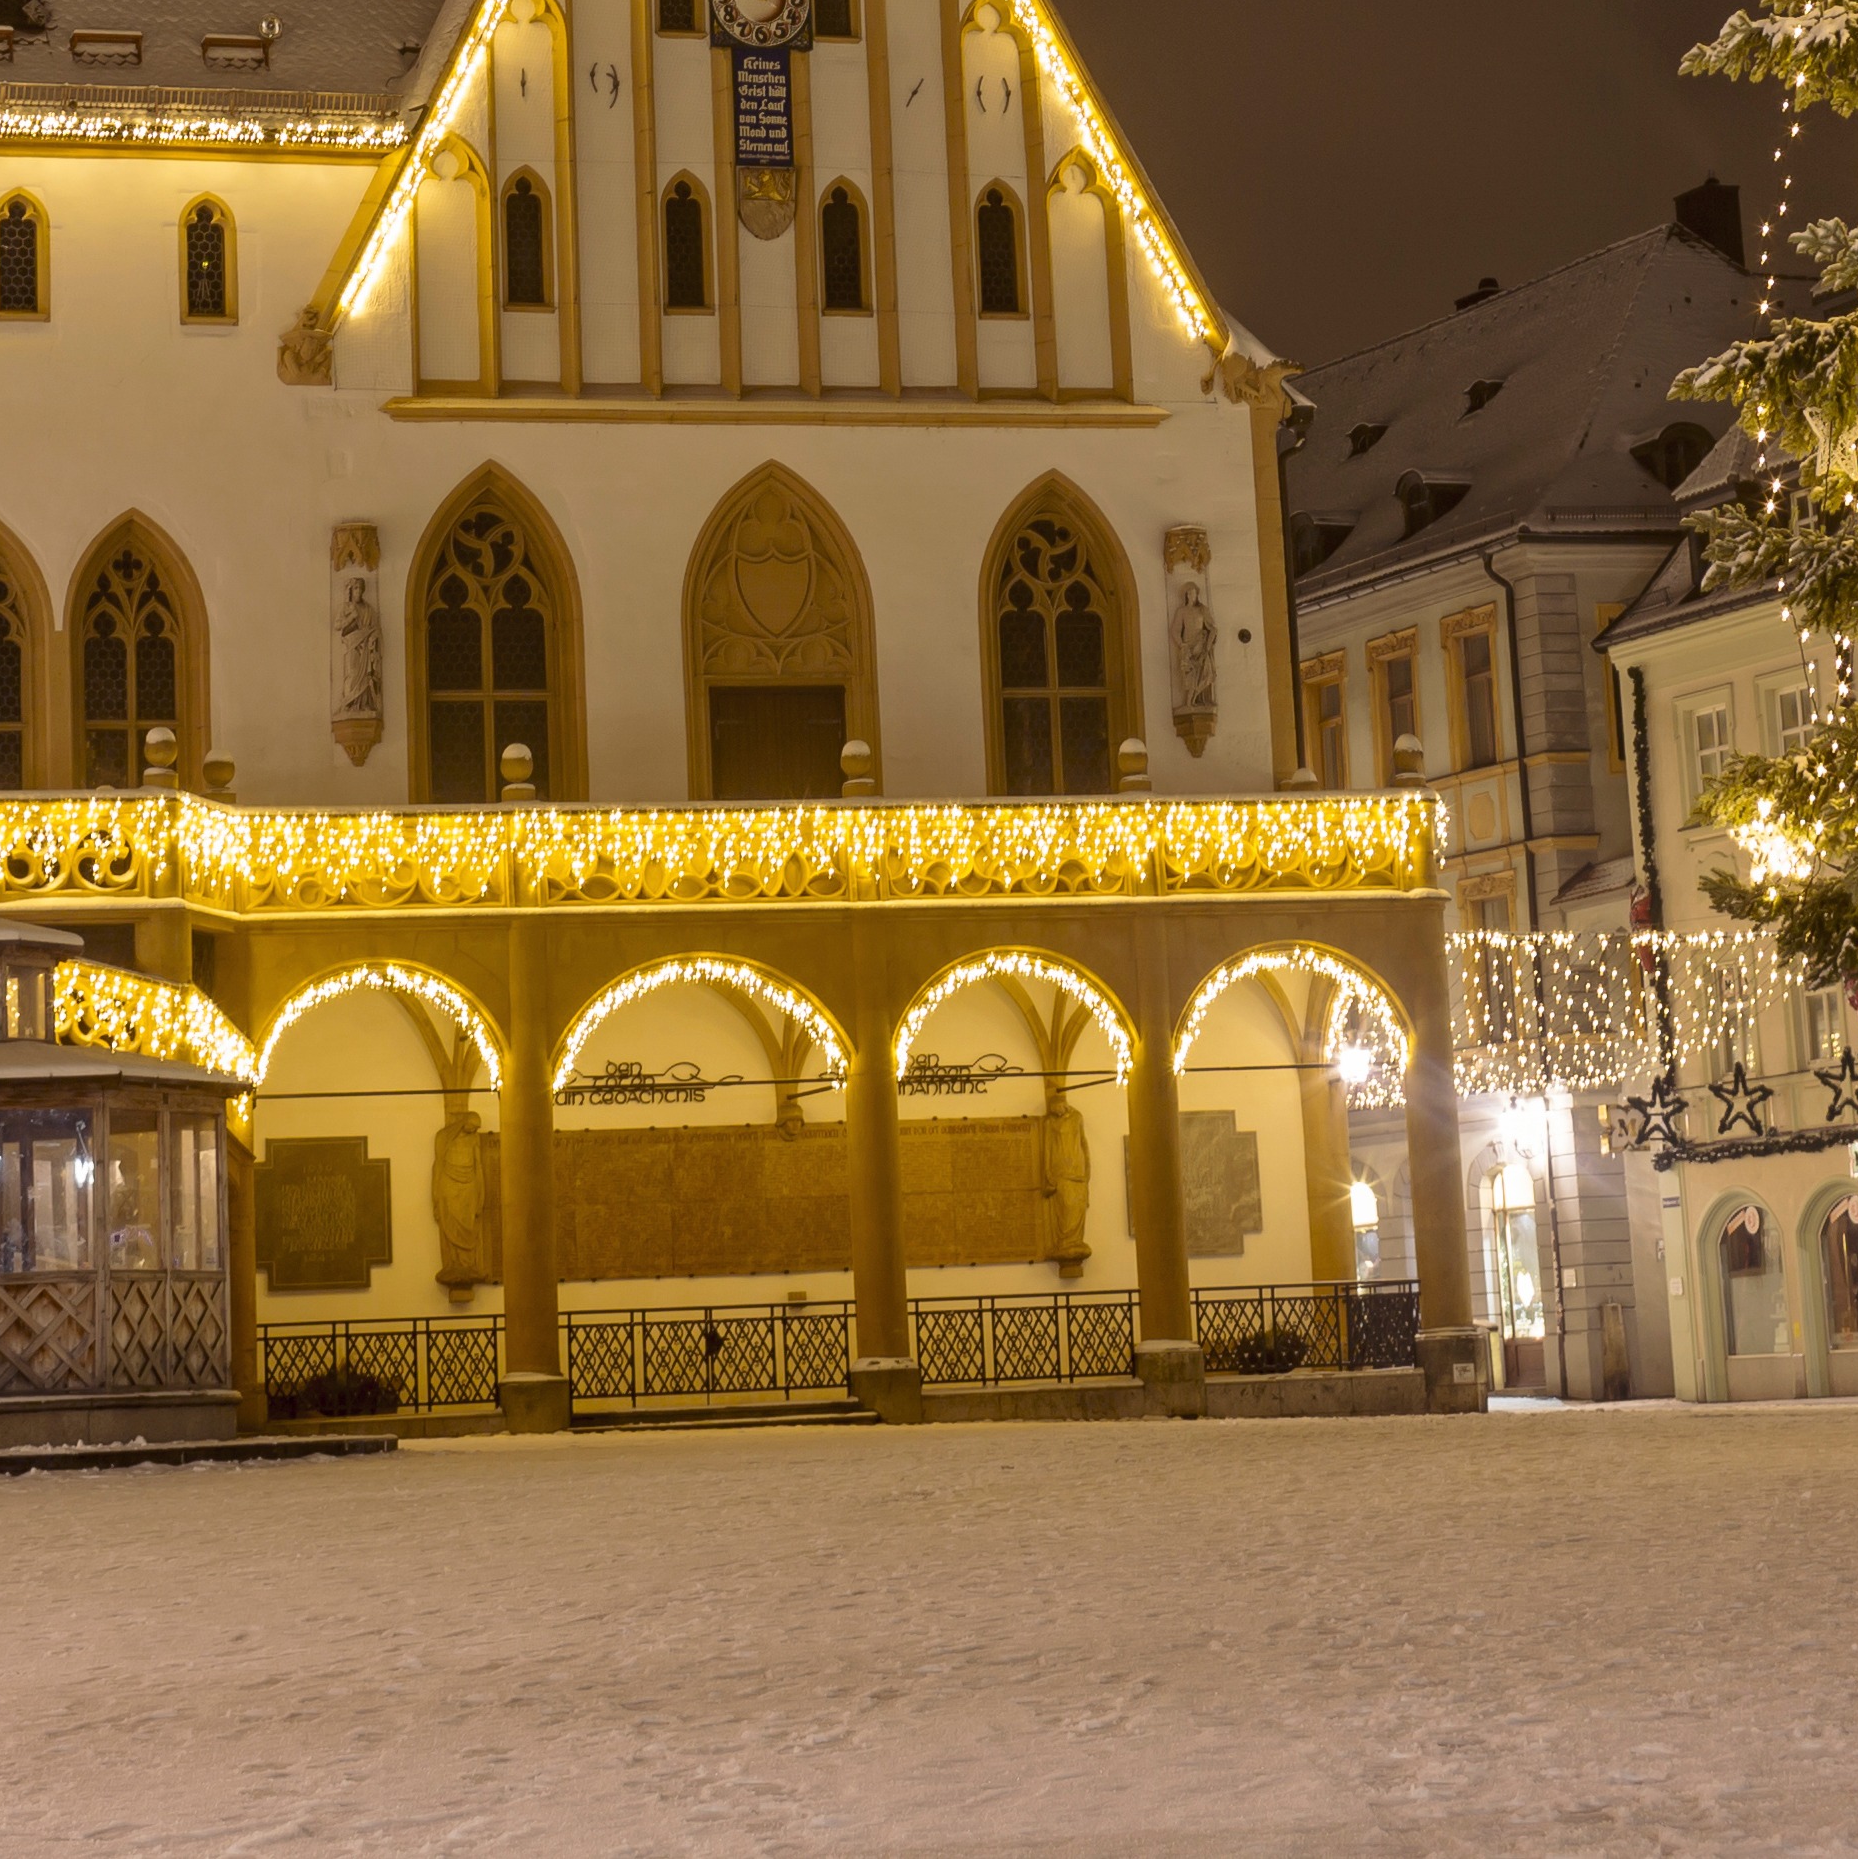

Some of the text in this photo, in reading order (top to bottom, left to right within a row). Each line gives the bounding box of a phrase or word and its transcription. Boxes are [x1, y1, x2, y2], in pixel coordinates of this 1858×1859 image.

[723, 5, 736, 22] 8
[787, 8, 801, 26] 4
[736, 22, 749, 38] 7
[755, 26, 768, 43] 6
[773, 22, 788, 39] 5
[738, 71, 786, 84] Menschen
[738, 85, 766, 96] Geist
[740, 98, 786, 112] den Lauf
[739, 114, 756, 123] von
[739, 126, 787, 139] Mond und
[739, 139, 773, 152] Sternen
